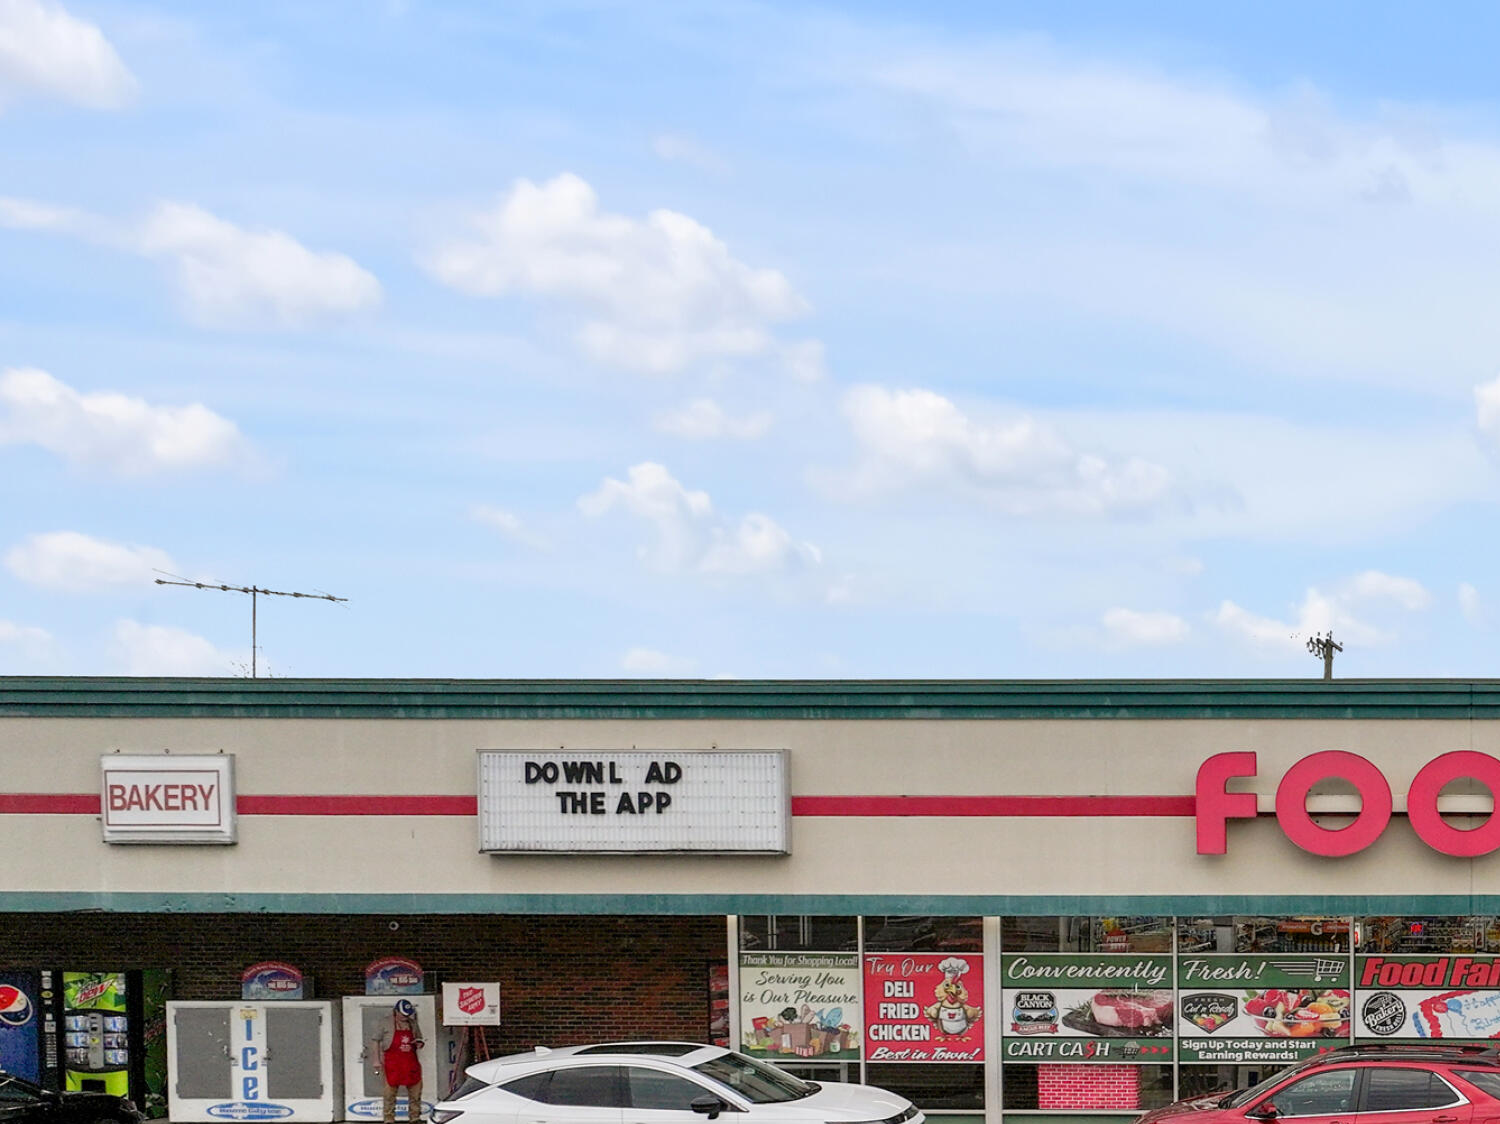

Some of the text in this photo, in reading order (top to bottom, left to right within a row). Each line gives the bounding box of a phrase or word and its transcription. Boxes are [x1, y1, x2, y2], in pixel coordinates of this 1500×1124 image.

[109, 784, 215, 811] BAKERY
[556, 792, 672, 815] THE APP
[743, 955, 768, 964] Thank
[769, 955, 784, 964] You
[783, 955, 797, 967] for
[798, 955, 835, 967] Shopping
[865, 957, 934, 977] Try Our
[755, 970, 846, 989] Serving You
[1007, 957, 1267, 985] Conveniently Fresh!
[1360, 957, 1449, 987] Food
[743, 989, 859, 1004] is Our Pleasure.
[884, 980, 914, 998] DELI
[879, 1003, 920, 1019] FRIED
[1017, 1000, 1053, 1009] CANYON
[1364, 1000, 1404, 1028] Bakery
[868, 1024, 931, 1041] CHICKEN
[870, 1046, 981, 1060] Best in Town!
[1008, 1042, 1057, 1057] CART
[1182, 1040, 1316, 1051] Sign Up Today and Start
[1199, 1051, 1299, 1062] Earning Rewards!
